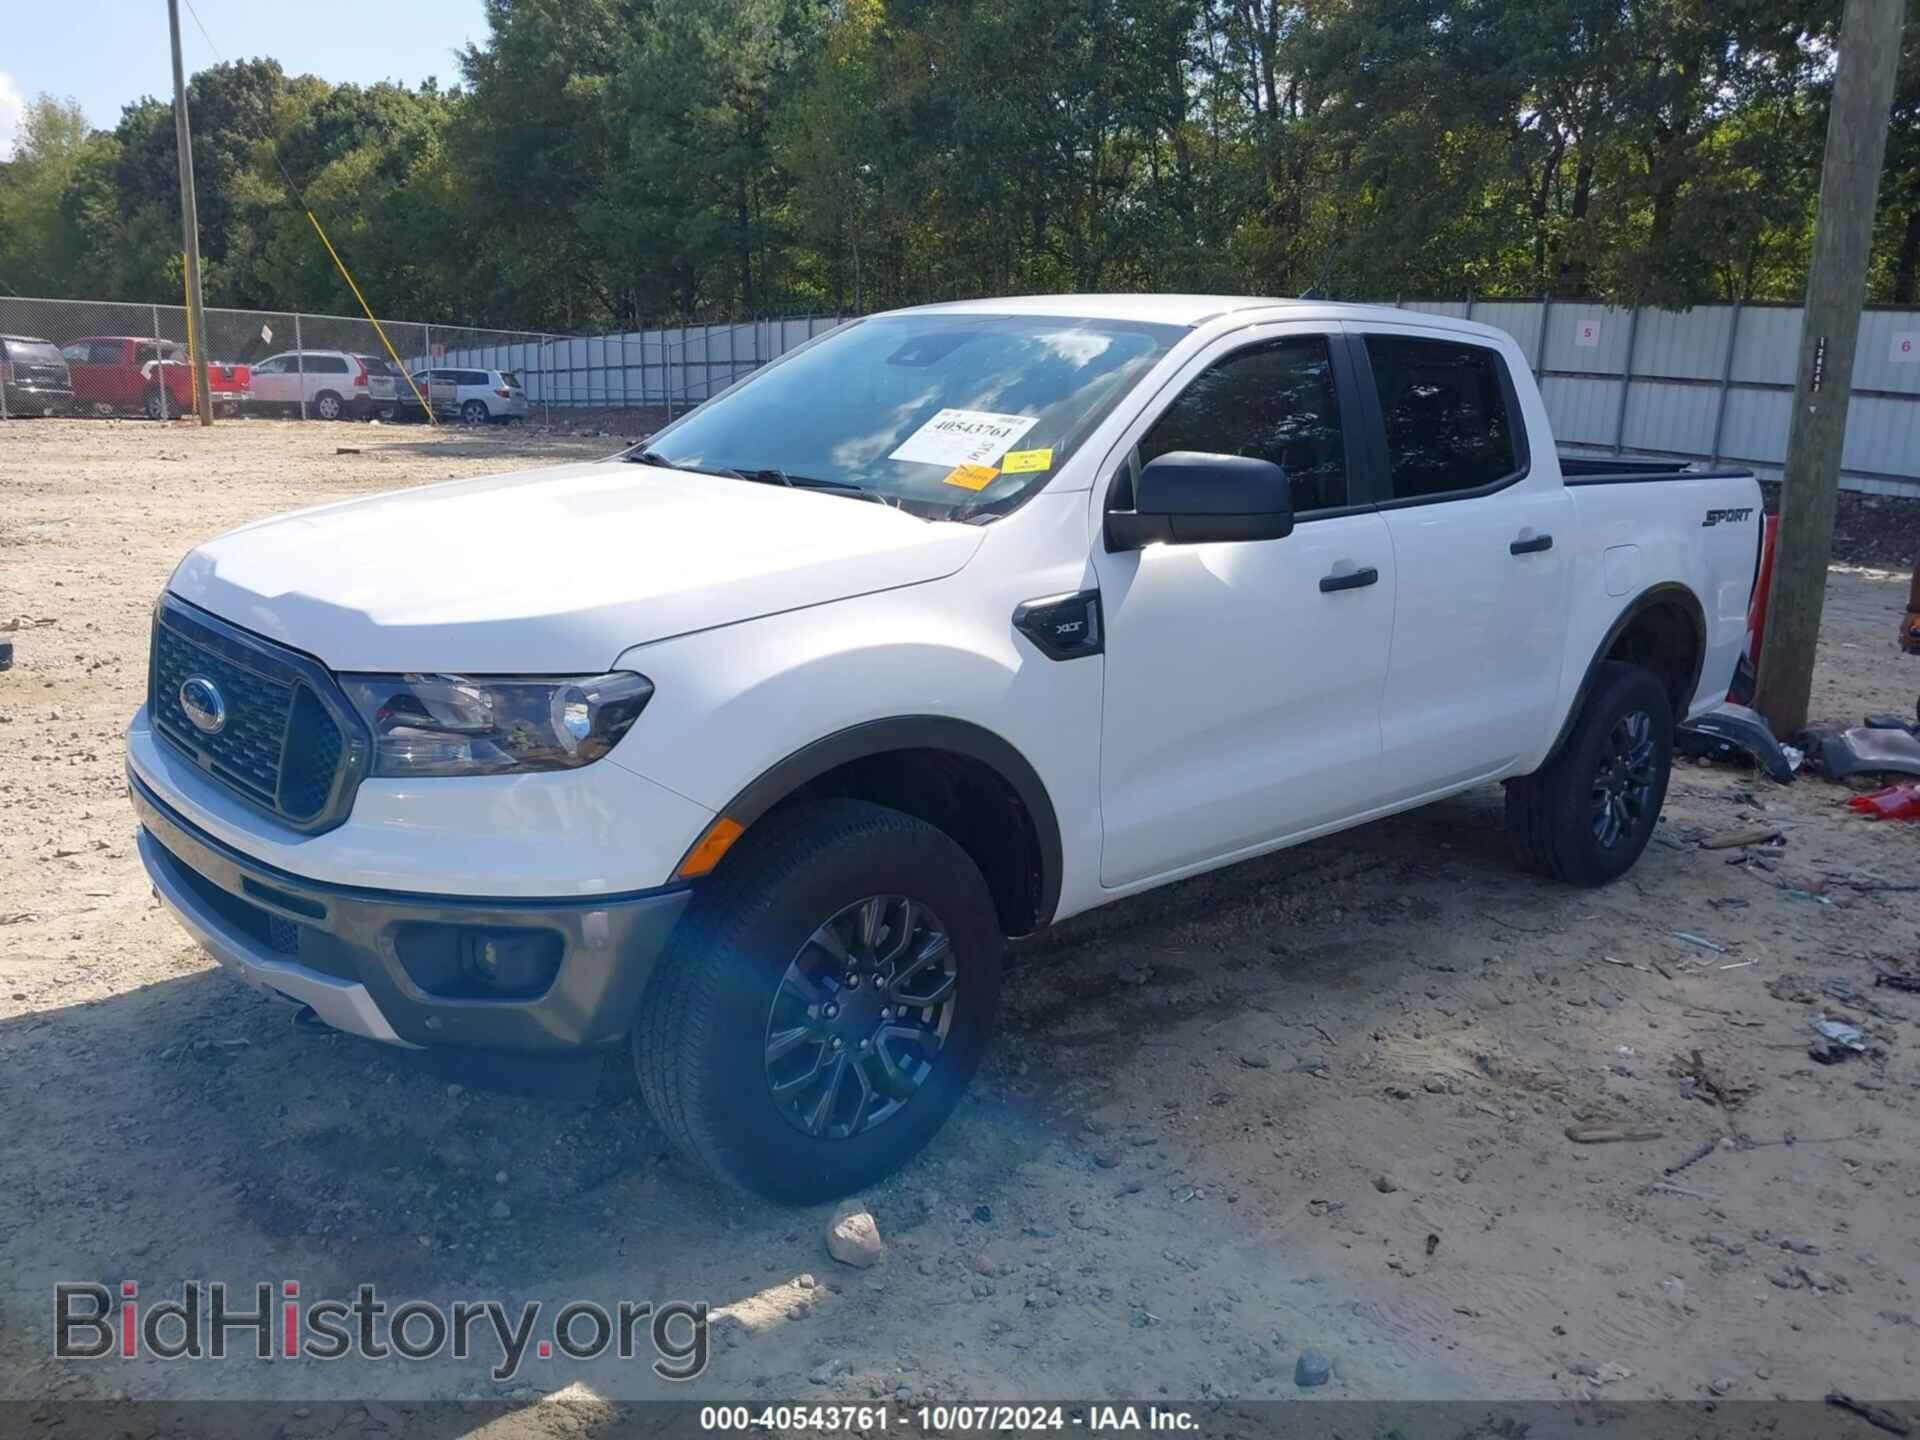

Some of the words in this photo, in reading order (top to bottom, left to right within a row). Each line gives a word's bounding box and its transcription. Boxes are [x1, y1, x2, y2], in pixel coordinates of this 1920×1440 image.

[1583, 327, 1593, 338] 5
[1902, 340, 1911, 353] 6
[934, 419, 1013, 438] 40543761
[1702, 508, 1753, 527] SPORT
[1056, 620, 1084, 634] XLT
